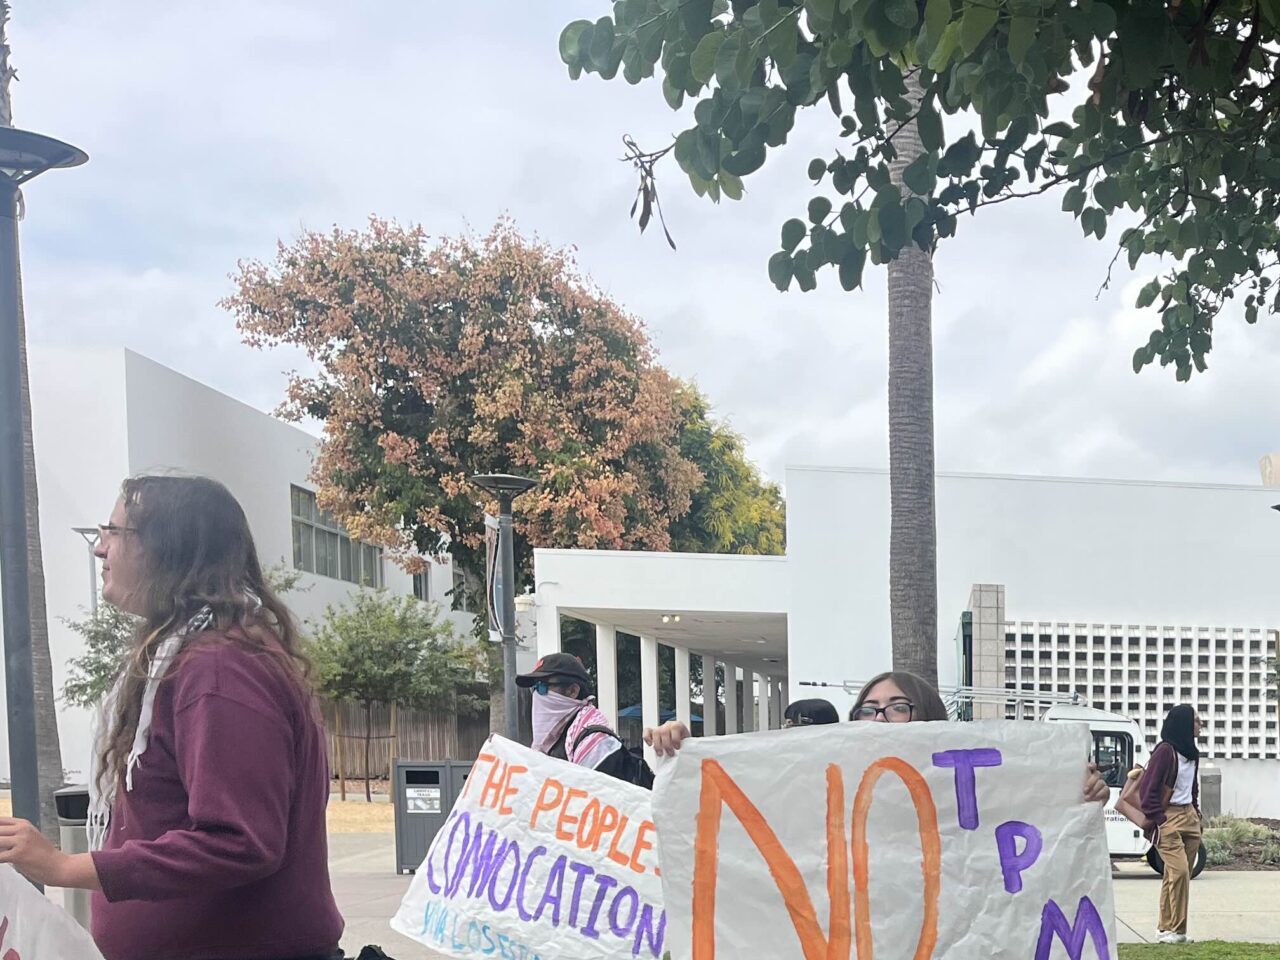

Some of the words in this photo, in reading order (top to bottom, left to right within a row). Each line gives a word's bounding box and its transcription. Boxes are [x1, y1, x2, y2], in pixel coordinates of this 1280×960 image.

[462, 752, 528, 816] THE
[529, 777, 661, 876] PEOPLE
[426, 810, 668, 959] CONVOCATION
